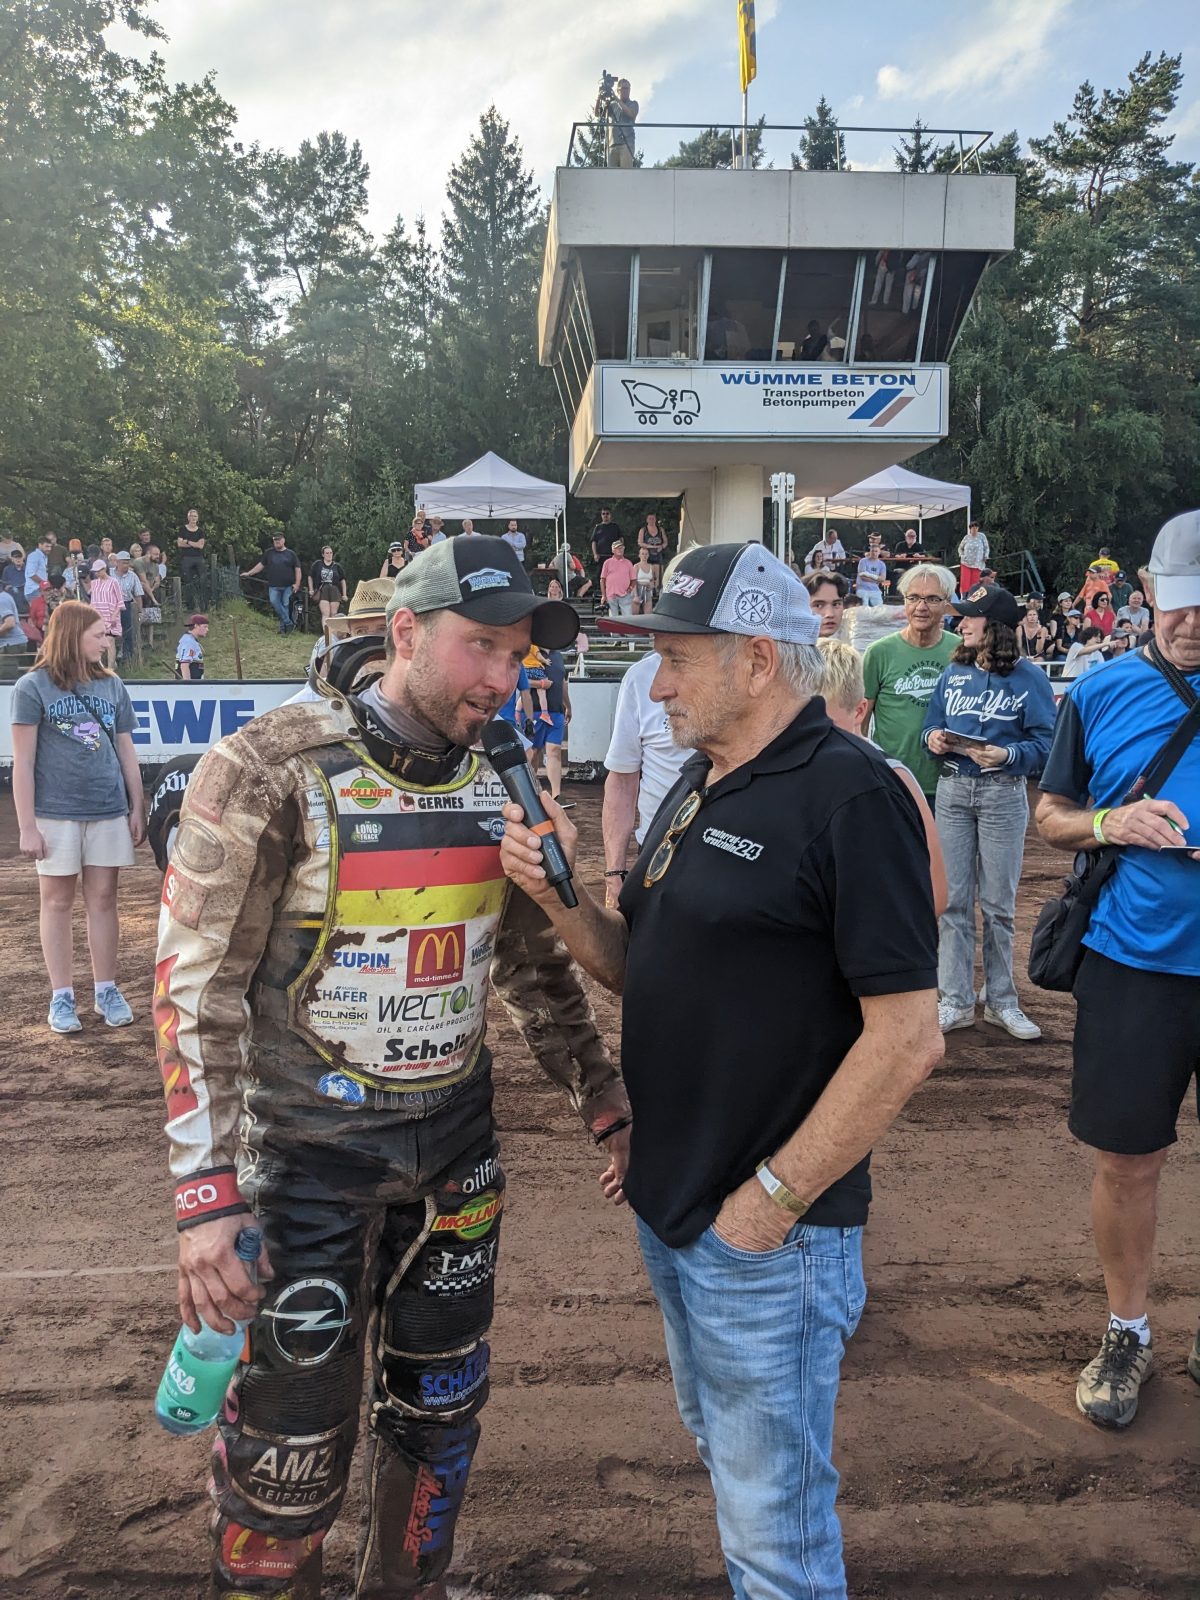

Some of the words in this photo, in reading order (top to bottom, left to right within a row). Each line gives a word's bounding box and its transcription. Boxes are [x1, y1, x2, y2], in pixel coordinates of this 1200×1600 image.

[720, 370, 823, 385] WÜMME
[831, 374, 916, 386] BETON
[762, 388, 865, 400] Transportbeton
[762, 398, 857, 408] Betonpumpen
[904, 660, 945, 677] REGISTERE
[944, 688, 978, 716] New
[355, 823, 378, 834] LONG
[333, 951, 390, 968] ZUPIN
[376, 1026, 391, 1034] OIL
[407, 1022, 444, 1033] CARCARE
[288, 1280, 339, 1293] OPEL
[177, 1407, 192, 1418] bio
[250, 1446, 331, 1481] AMZ
[256, 1486, 318, 1503] LEIPZIG
